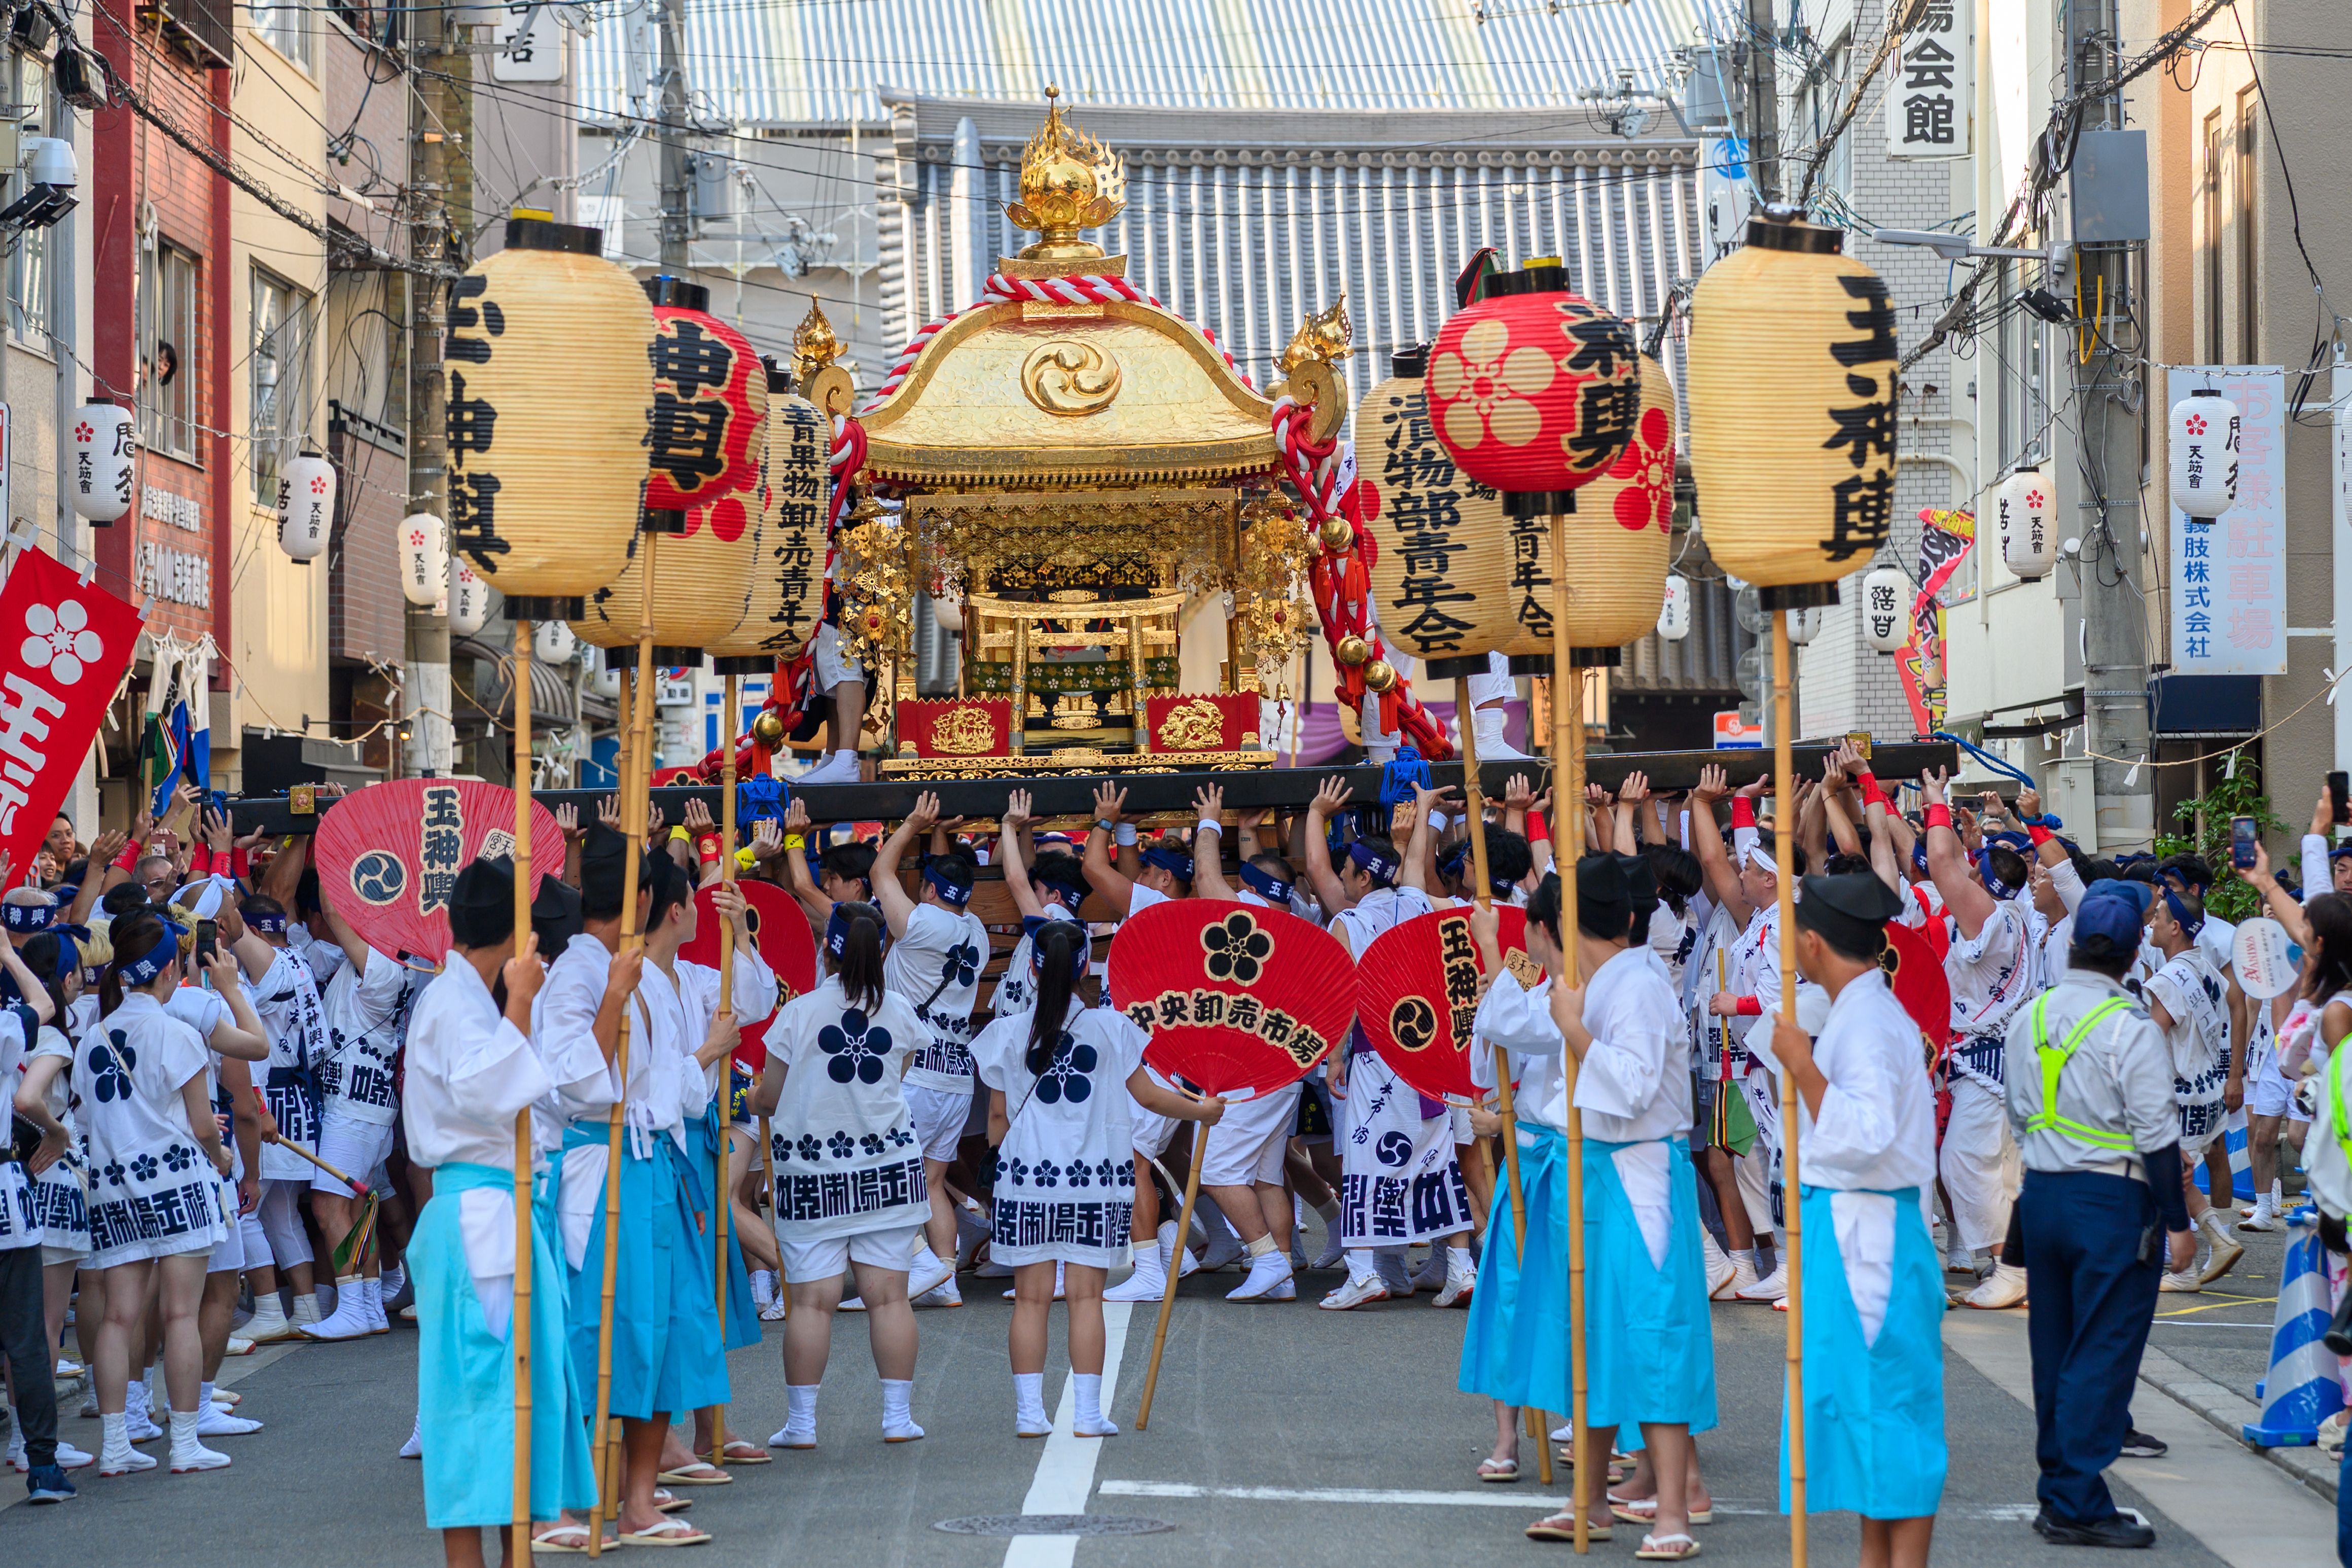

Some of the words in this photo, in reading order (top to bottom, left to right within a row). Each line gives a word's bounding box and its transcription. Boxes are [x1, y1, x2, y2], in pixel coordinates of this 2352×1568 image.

[758, 404, 820, 650] 青果物卸売青年会
[1125, 993, 1325, 1066] 中央卸売市場
